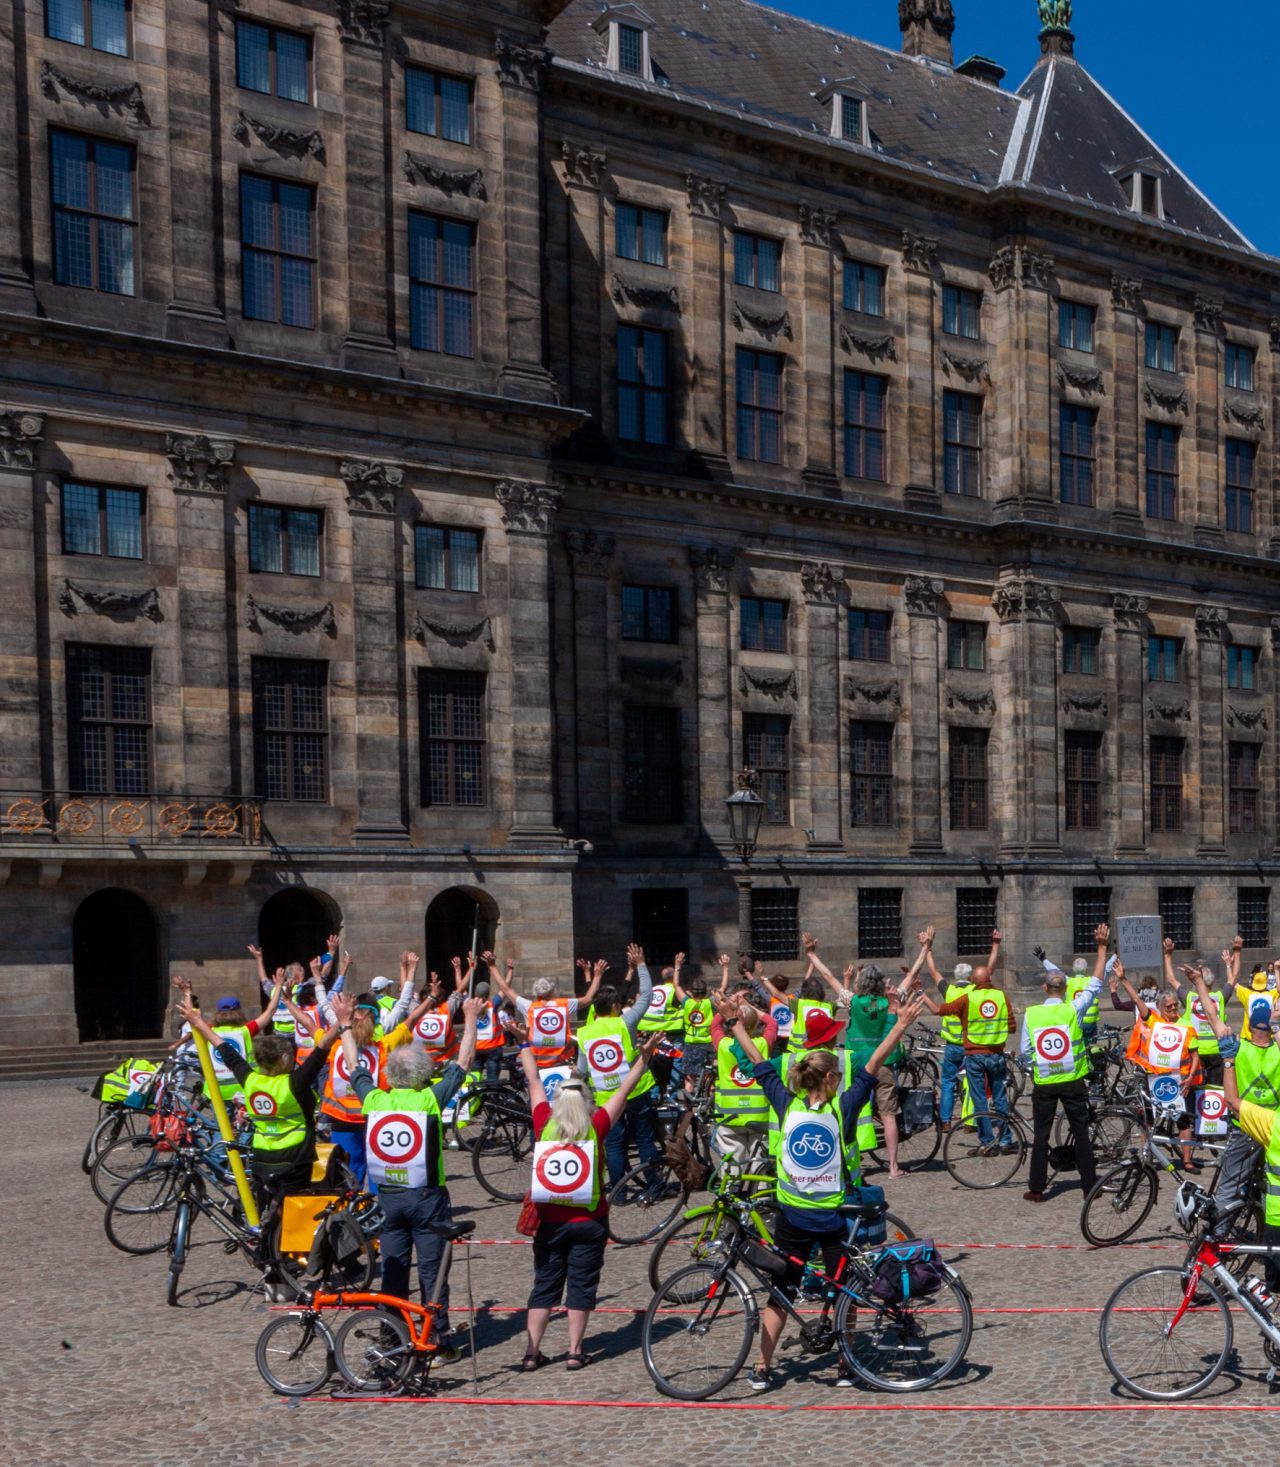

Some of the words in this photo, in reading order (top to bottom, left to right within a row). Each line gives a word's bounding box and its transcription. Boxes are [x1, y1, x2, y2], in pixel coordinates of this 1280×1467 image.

[1122, 925, 1154, 935] FIETS
[983, 1005, 994, 1013] 30
[541, 1016, 559, 1026] 30
[421, 1022, 438, 1031] 30
[1160, 1034, 1177, 1044] 30
[1044, 1038, 1063, 1051] 30
[595, 1048, 616, 1063] 30
[255, 1100, 272, 1110] 30
[1203, 1100, 1220, 1110] 30
[381, 1131, 412, 1147] 30
[548, 1159, 579, 1176] 30
